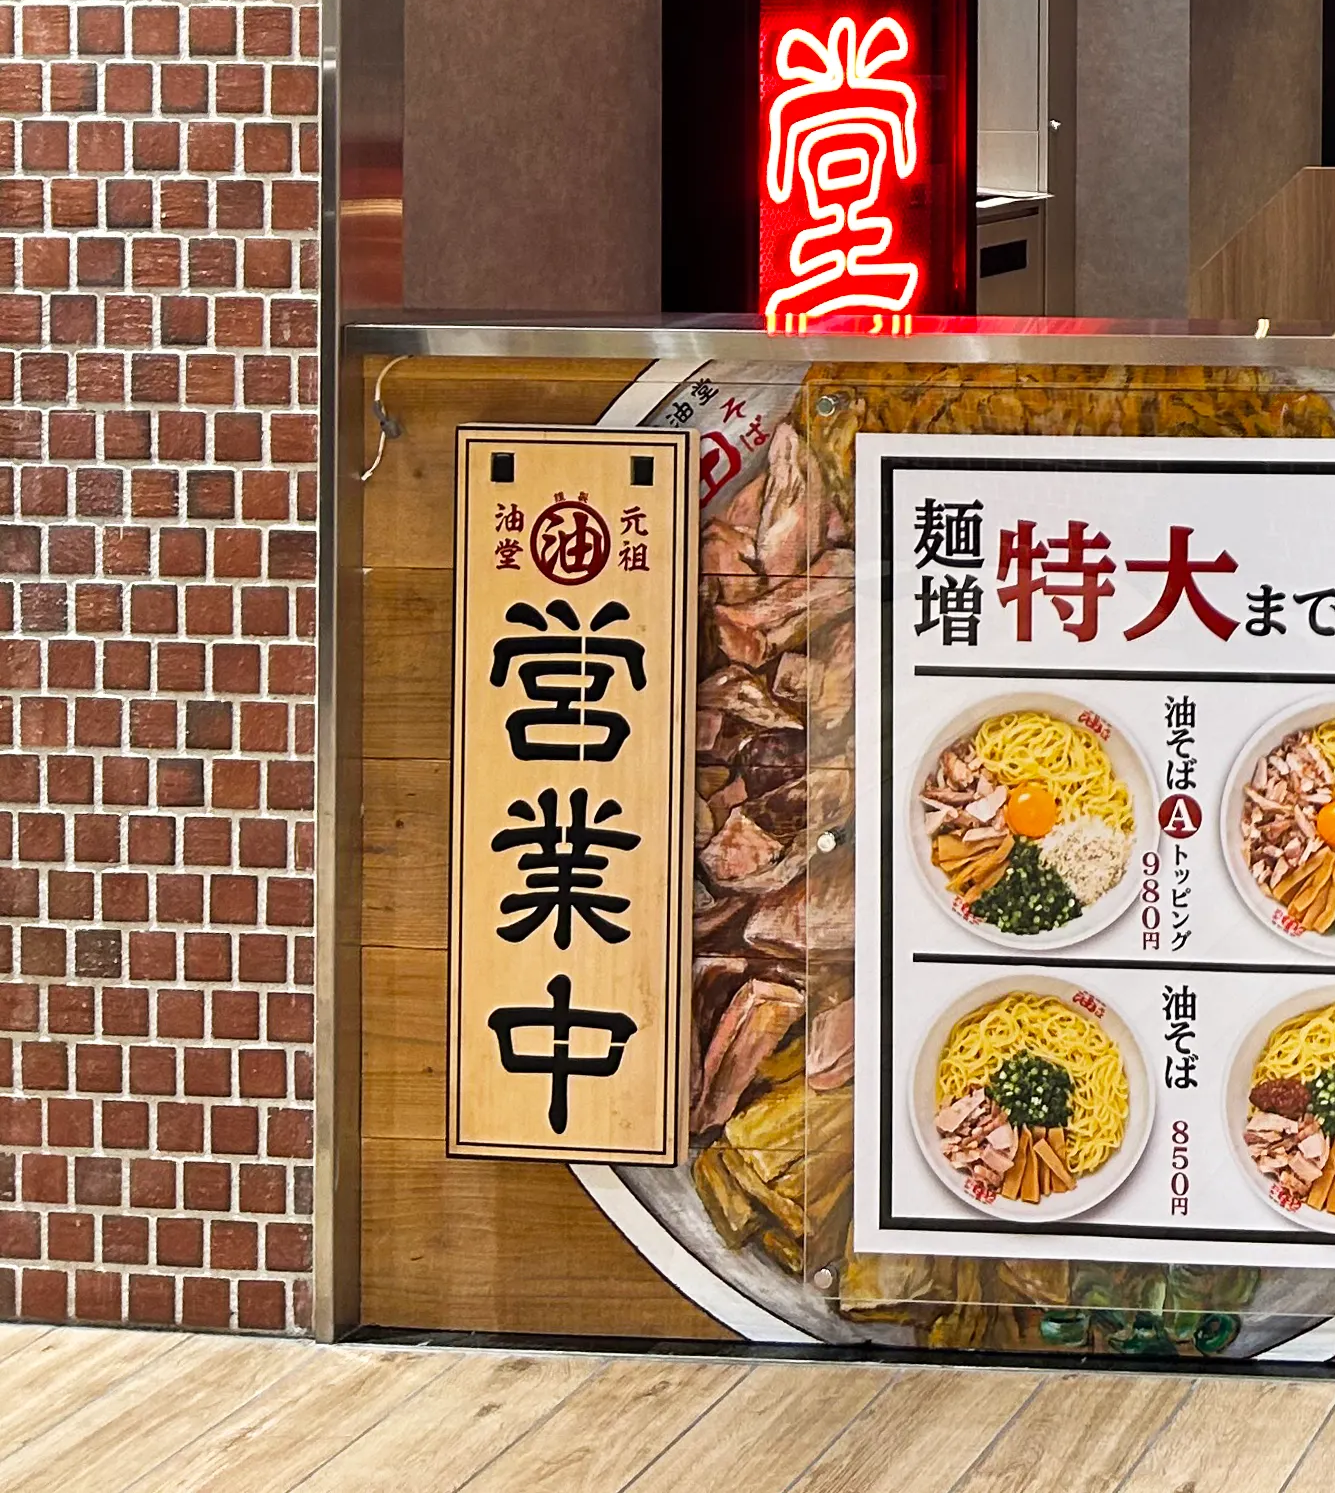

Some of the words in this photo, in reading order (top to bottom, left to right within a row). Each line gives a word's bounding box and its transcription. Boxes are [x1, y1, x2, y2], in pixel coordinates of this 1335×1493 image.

[494, 502, 526, 571] 油堂
[537, 507, 606, 580] 油
[617, 505, 650, 572] 元祖
[912, 497, 985, 647] 麺増
[488, 598, 648, 1135] 営業中
[1142, 852, 1161, 952] 980円
[1161, 984, 1199, 1090] 油そば
[1169, 1121, 1190, 1217] 850円
